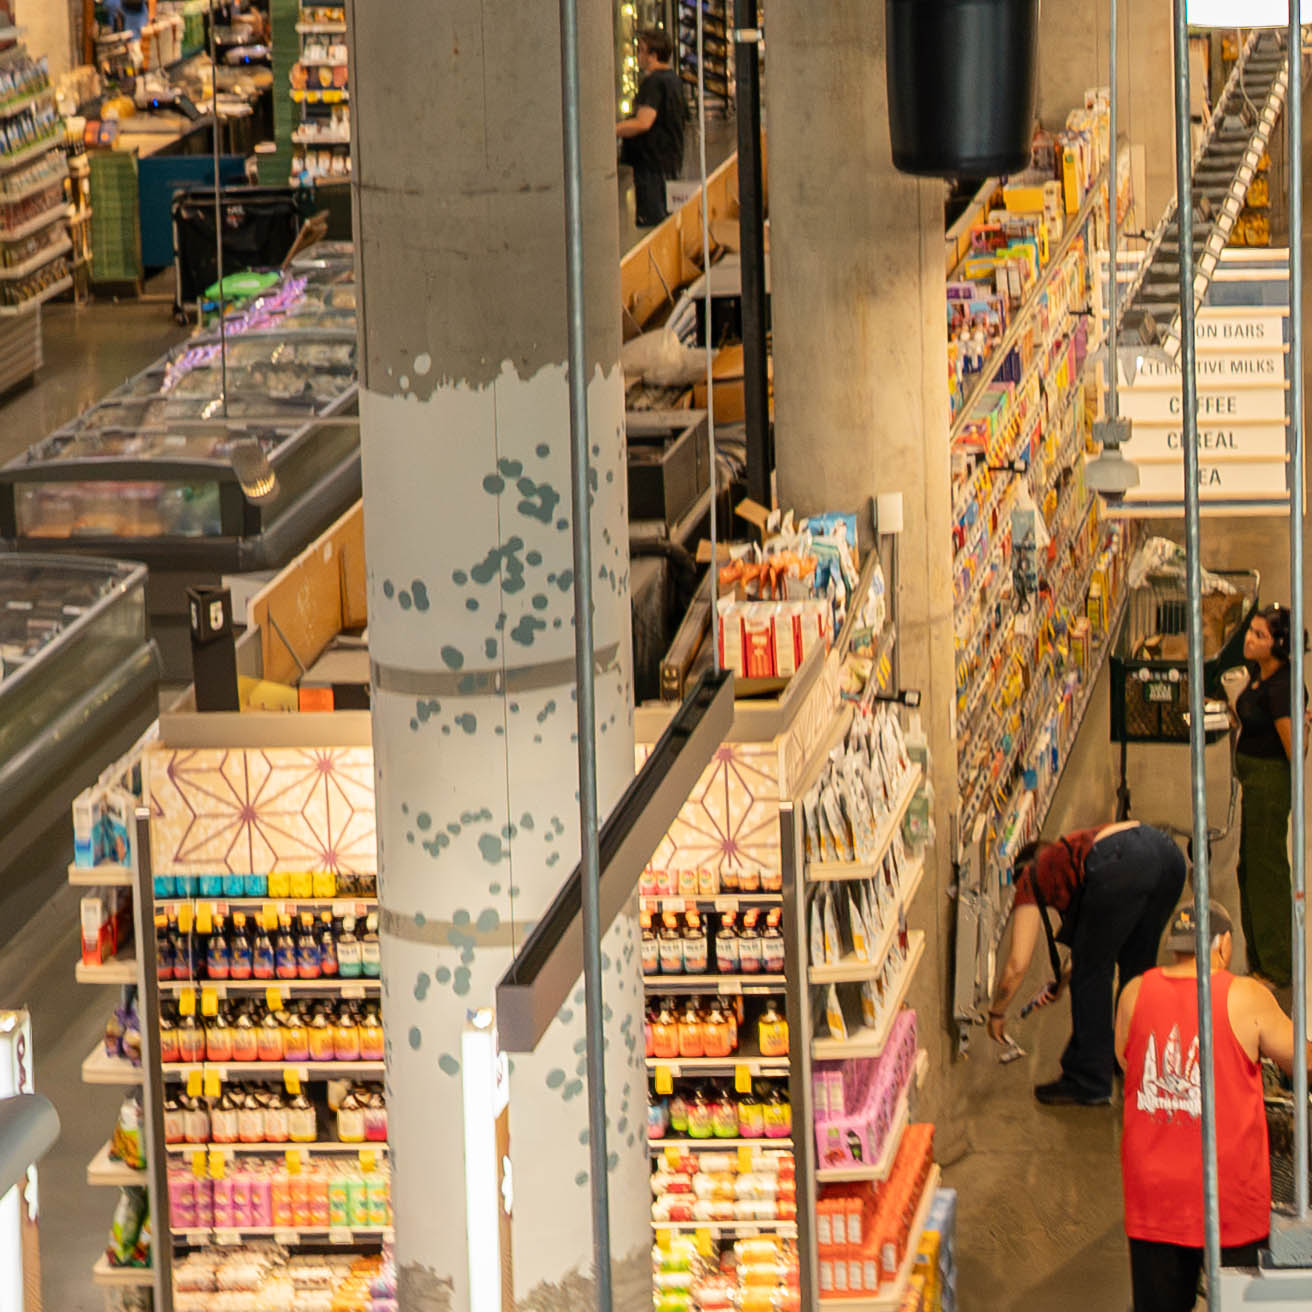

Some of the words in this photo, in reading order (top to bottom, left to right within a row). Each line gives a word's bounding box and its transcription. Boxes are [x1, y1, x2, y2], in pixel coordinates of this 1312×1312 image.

[1223, 323, 1265, 338] BARS
[1138, 358, 1225, 374] LTERNTIVE
[1230, 358, 1275, 374] MILKS
[1169, 395, 1236, 414] CFFEE
